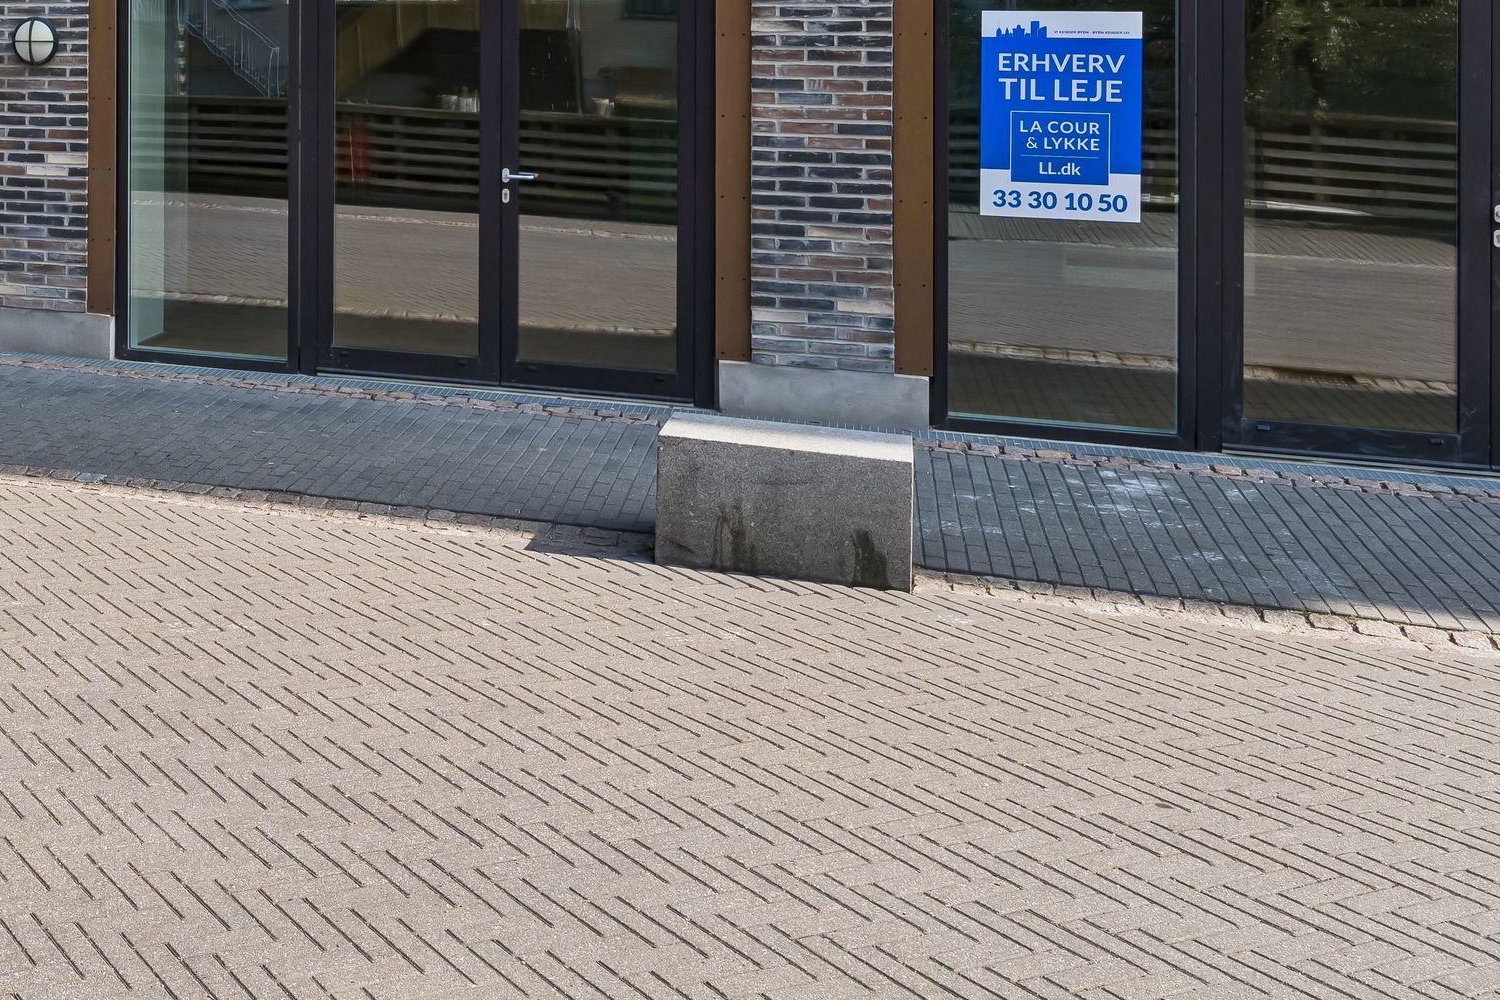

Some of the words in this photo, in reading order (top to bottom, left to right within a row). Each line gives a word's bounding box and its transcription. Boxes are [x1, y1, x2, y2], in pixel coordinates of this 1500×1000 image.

[998, 53, 1125, 73] ERHVERV
[998, 78, 1045, 101] TIL
[1054, 79, 1123, 102] LEJE
[1019, 120, 1042, 133] LA
[1048, 121, 1100, 135] COUR
[1026, 137, 1038, 149] &
[1044, 137, 1100, 150] LYKKE
[1039, 162, 1081, 176] LL.dk
[992, 190, 1021, 207] 33
[1028, 191, 1058, 209] 30
[1065, 192, 1092, 211] 10
[1098, 194, 1127, 212] 50
